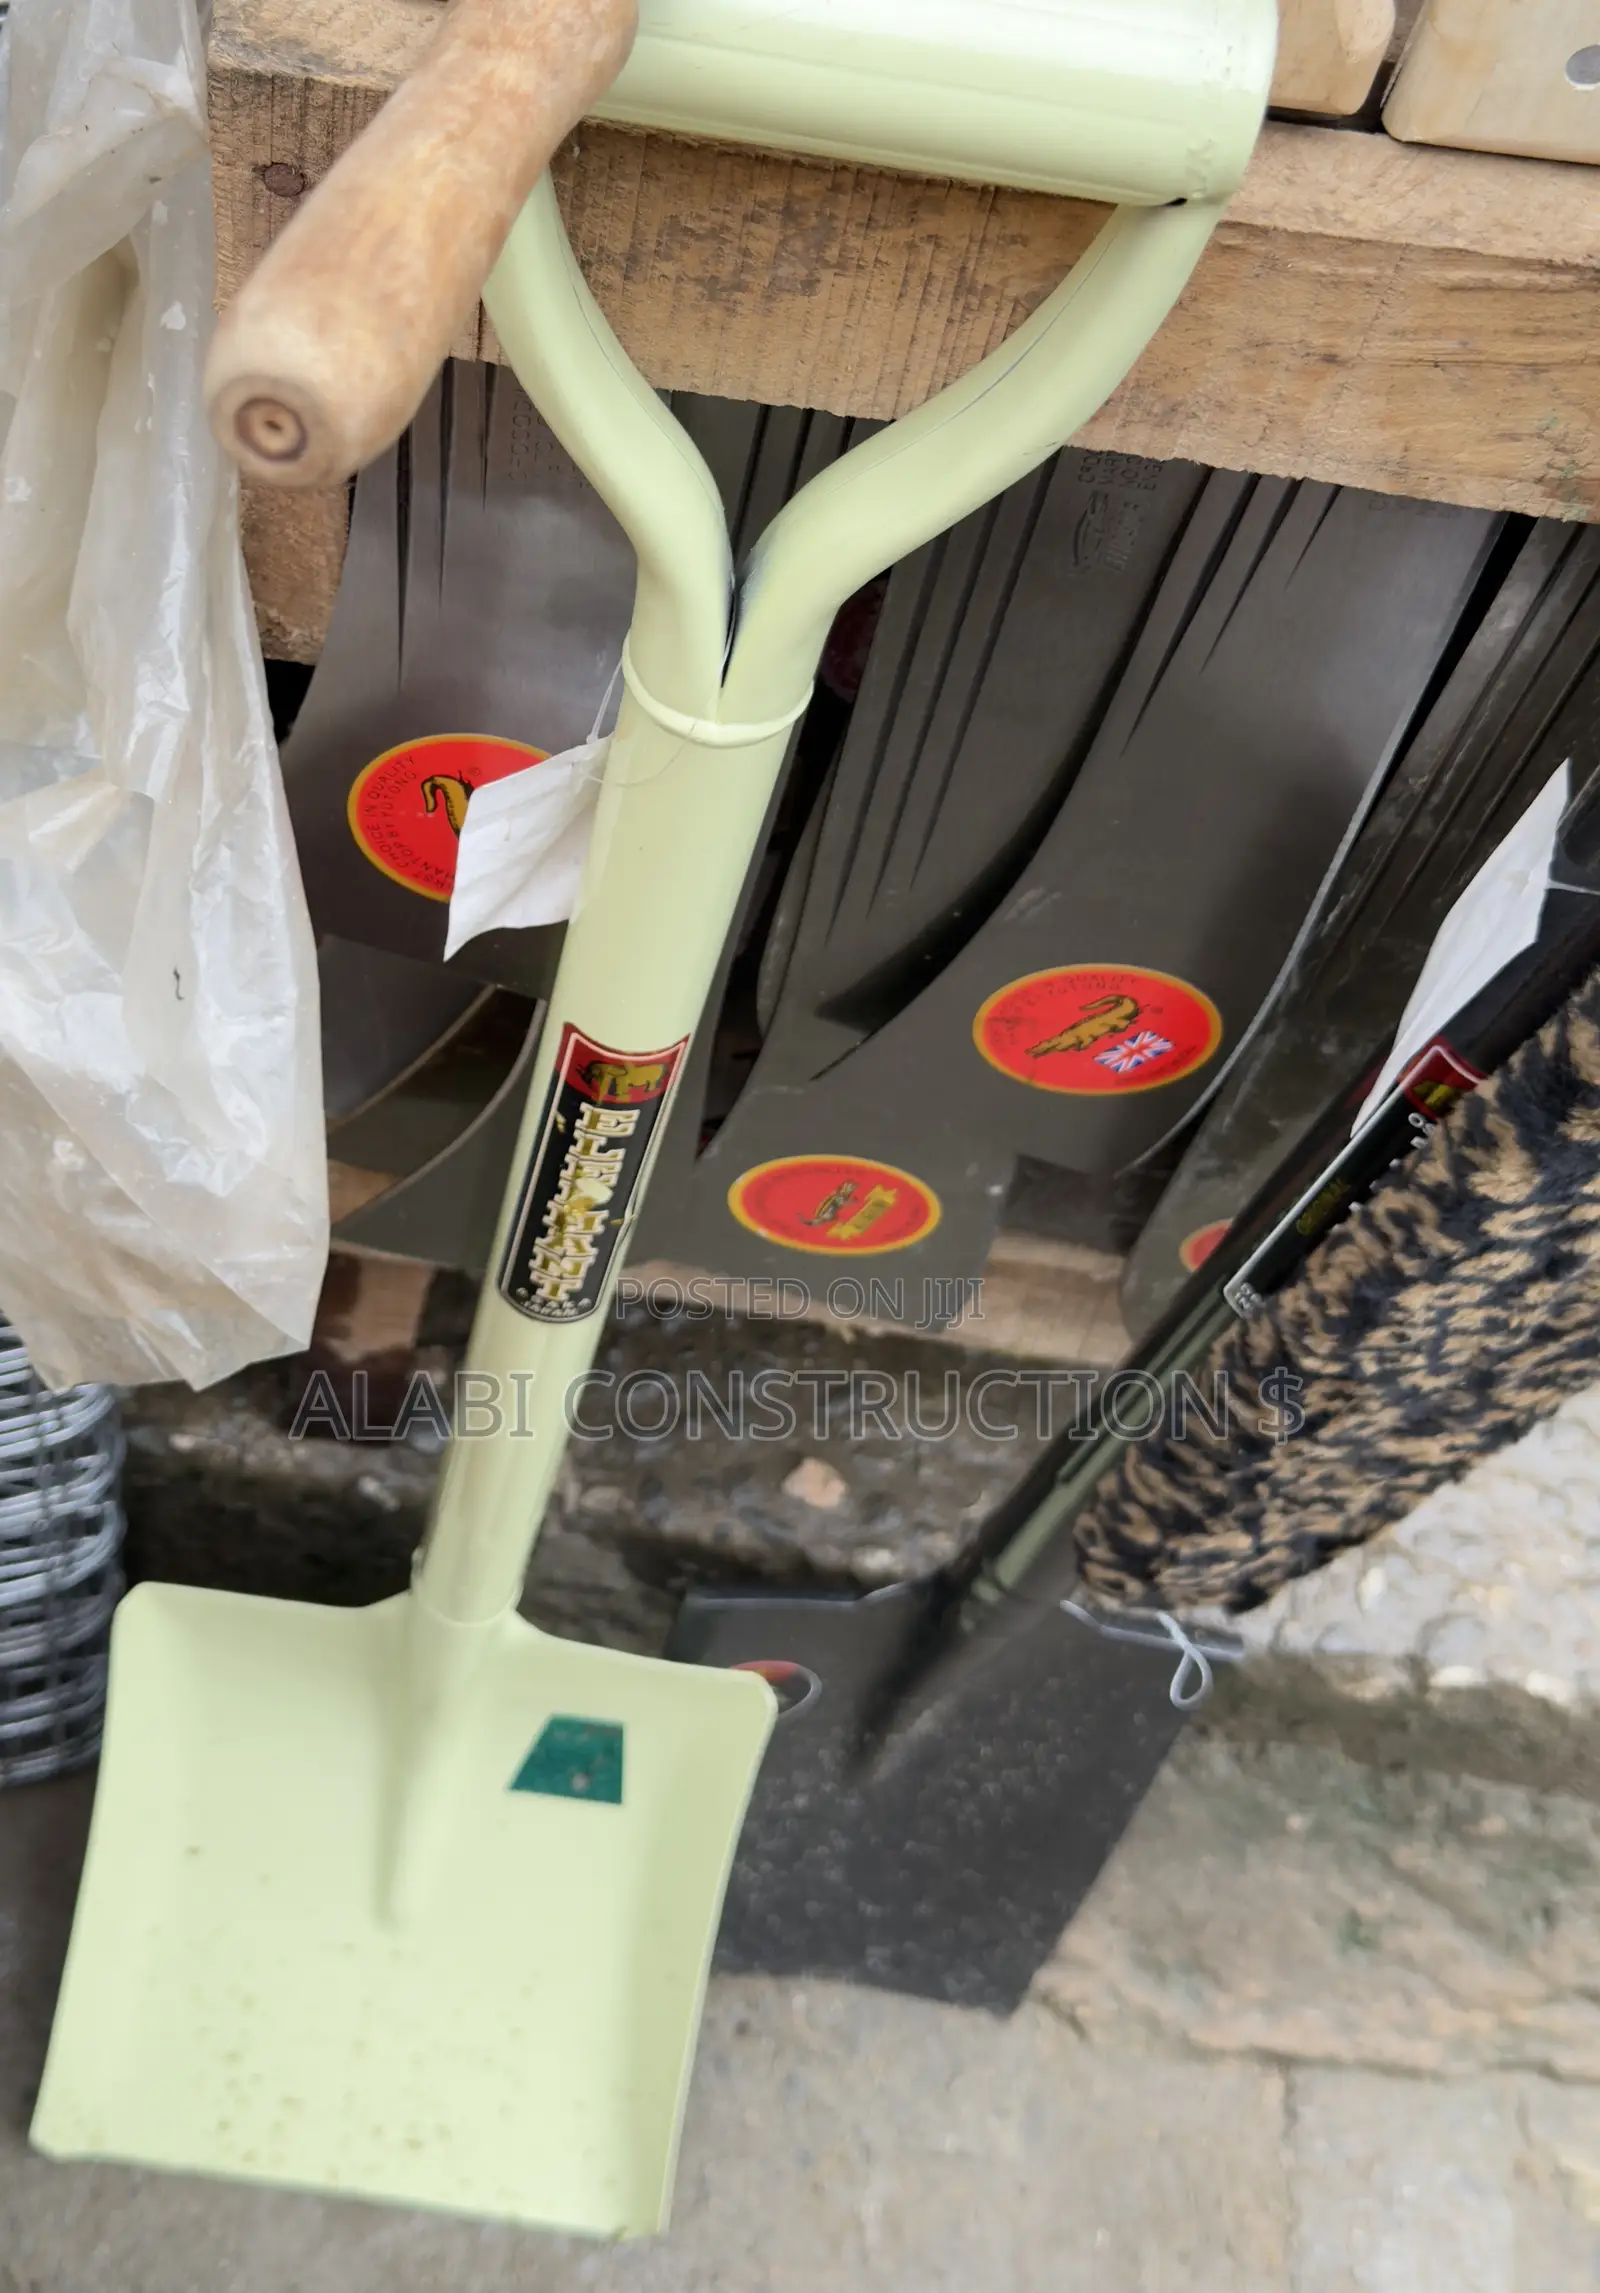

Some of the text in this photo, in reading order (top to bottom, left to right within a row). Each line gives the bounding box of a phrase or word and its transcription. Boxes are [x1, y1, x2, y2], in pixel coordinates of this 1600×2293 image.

[368, 756, 414, 800] QUALITY
[382, 770, 418, 819] YUTONG
[364, 805, 377, 818] IN
[367, 823, 409, 869] CHOICE
